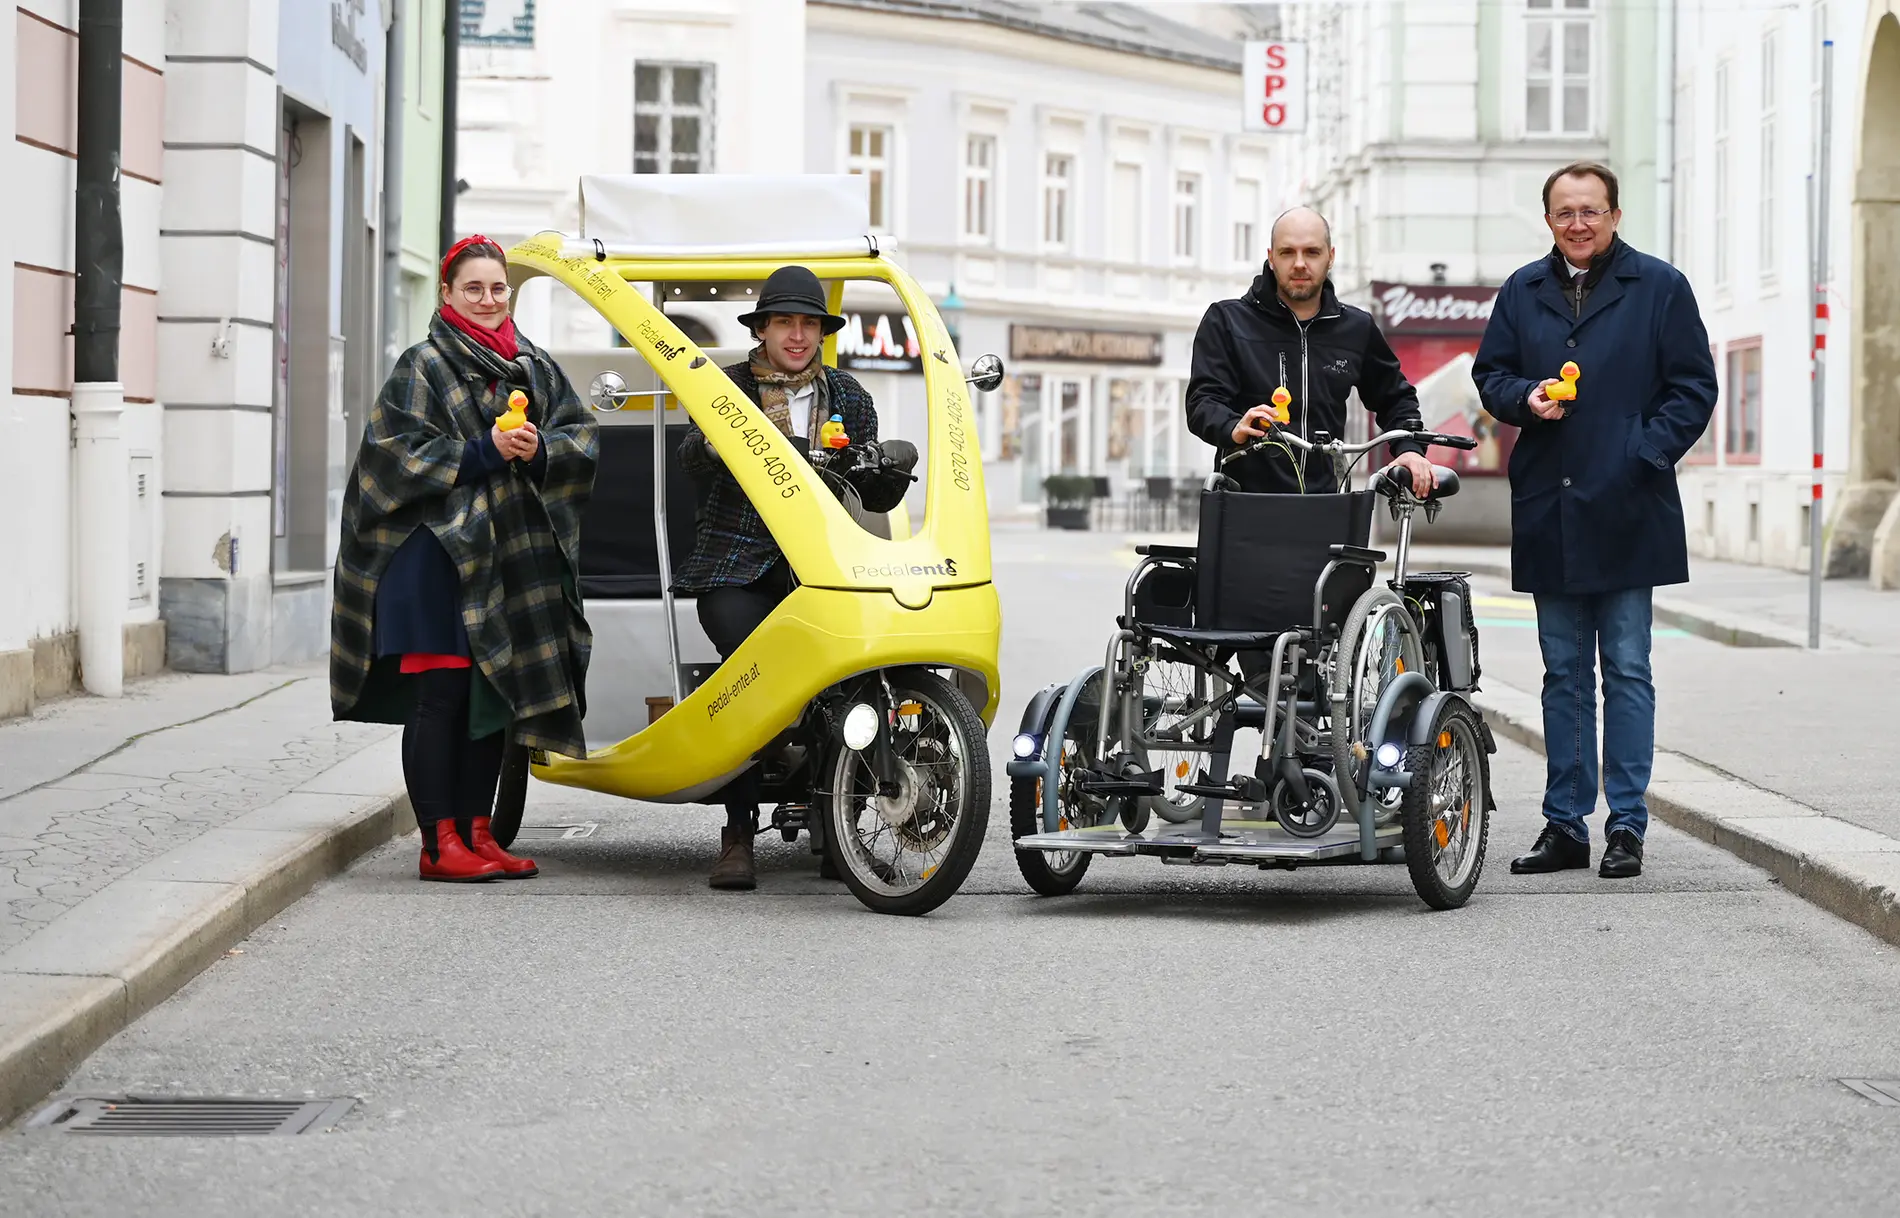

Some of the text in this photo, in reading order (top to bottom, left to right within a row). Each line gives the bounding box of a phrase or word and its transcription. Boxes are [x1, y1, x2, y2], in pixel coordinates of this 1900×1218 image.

[637, 319, 686, 361] Pedalente
[711, 395, 748, 429] 0670
[742, 428, 771, 456] 403
[949, 423, 965, 452] 403
[951, 452, 970, 491] 0670
[852, 558, 957, 579] Pedalente
[706, 661, 760, 722] pedal-ente.at
